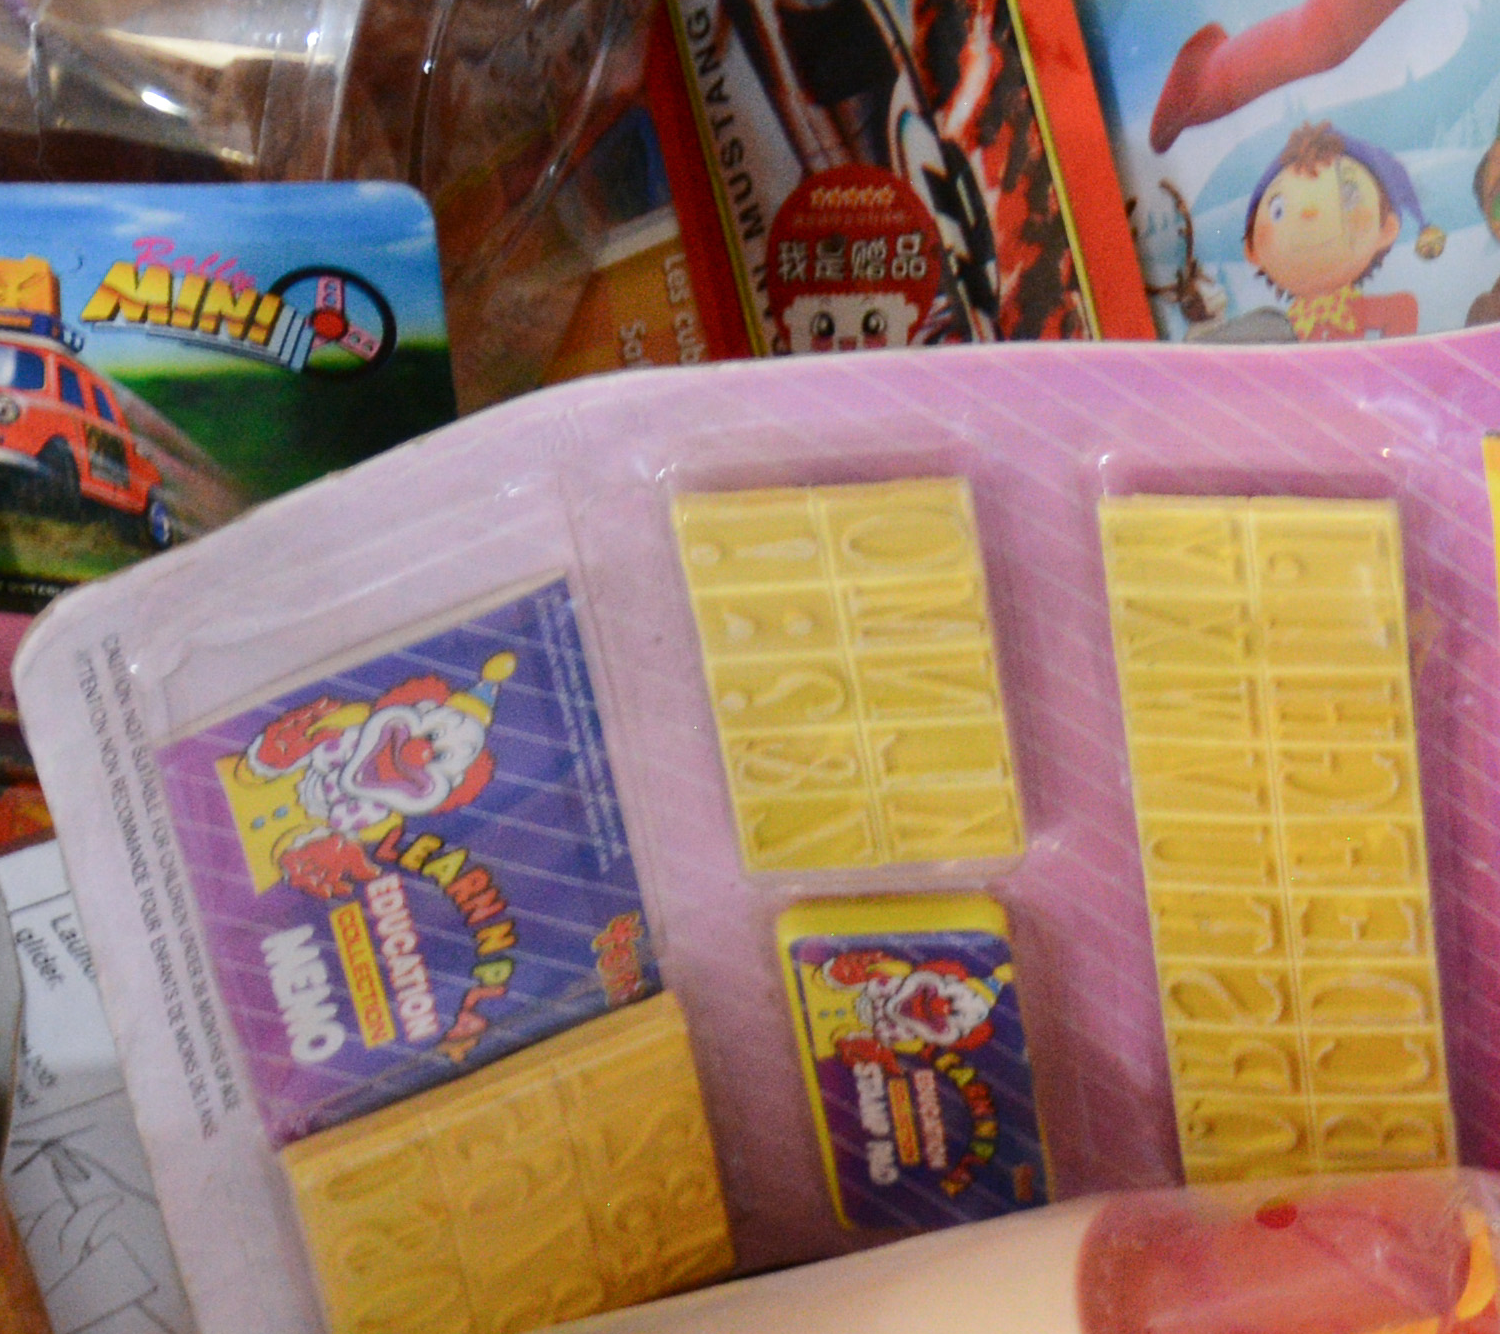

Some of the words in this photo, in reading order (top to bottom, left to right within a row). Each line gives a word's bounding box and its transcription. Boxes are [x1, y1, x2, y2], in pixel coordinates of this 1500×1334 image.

[688, 17, 766, 243] MUSTANG
[117, 707, 146, 744] NOT
[126, 743, 165, 815] SUITABLE
[145, 816, 174, 851] FOR
[368, 802, 509, 944] LEARN
[471, 918, 519, 958] N
[154, 851, 195, 929] CHILDREN
[146, 934, 184, 1003] ENFANTS
[256, 920, 350, 1069] MEMO
[332, 905, 392, 1045] COLLECTION
[362, 871, 444, 1044] EDUCATION
